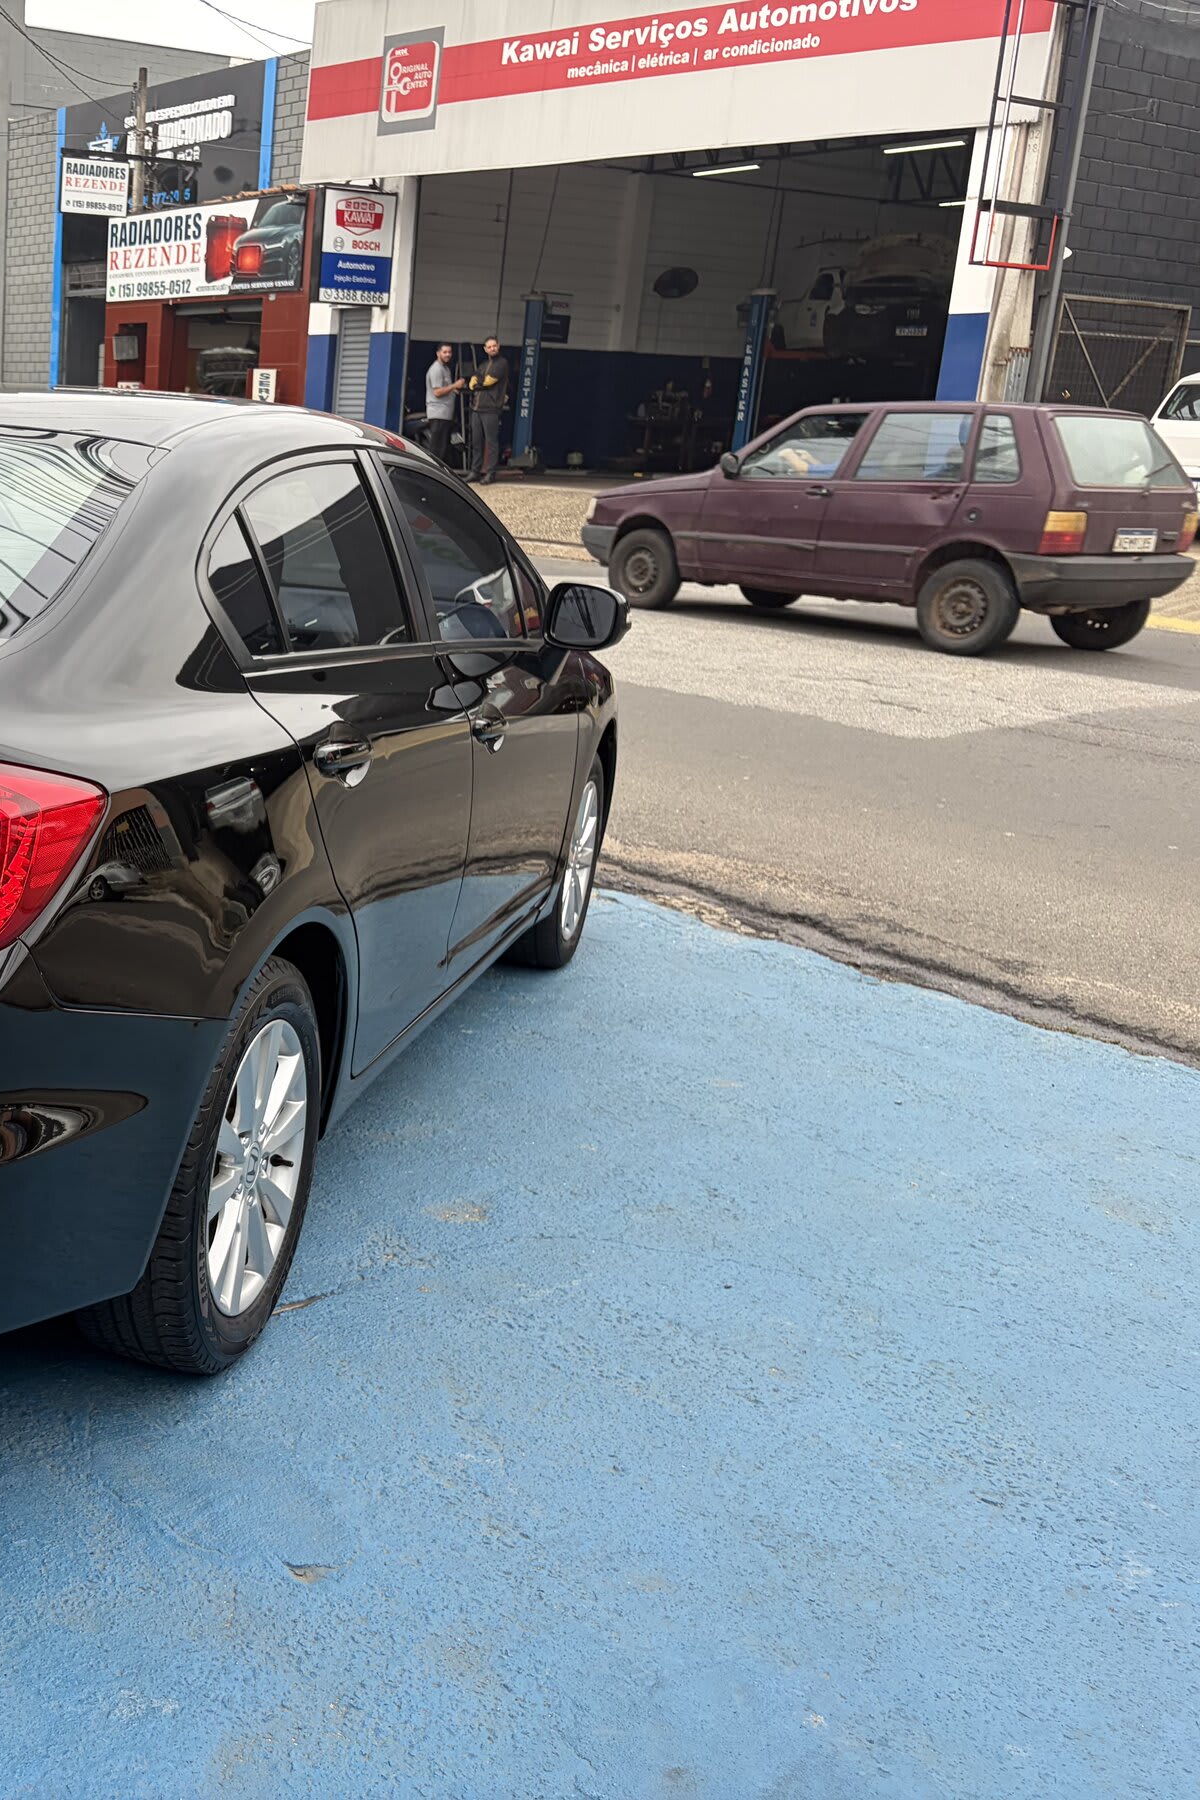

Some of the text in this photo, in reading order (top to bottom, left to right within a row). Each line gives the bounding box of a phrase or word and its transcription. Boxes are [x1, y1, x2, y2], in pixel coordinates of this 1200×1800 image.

[501, 31, 579, 65] Kawai
[588, 17, 708, 52] Serviços
[567, 33, 820, 79] mecânica elétrica ar condicionado
[390, 61, 428, 80] ORIGINAL
[413, 70, 432, 80] AUTO
[400, 76, 428, 95] CENTER
[65, 162, 126, 180] RADIADORES
[65, 176, 126, 192] REZENDE
[343, 210, 375, 224] KAWAI
[110, 213, 202, 248] RADIADORES
[351, 240, 380, 251] BOSCH
[109, 243, 201, 271] REZENDE
[118, 283, 134, 298] (15)
[136, 279, 191, 297] 99855-0512
